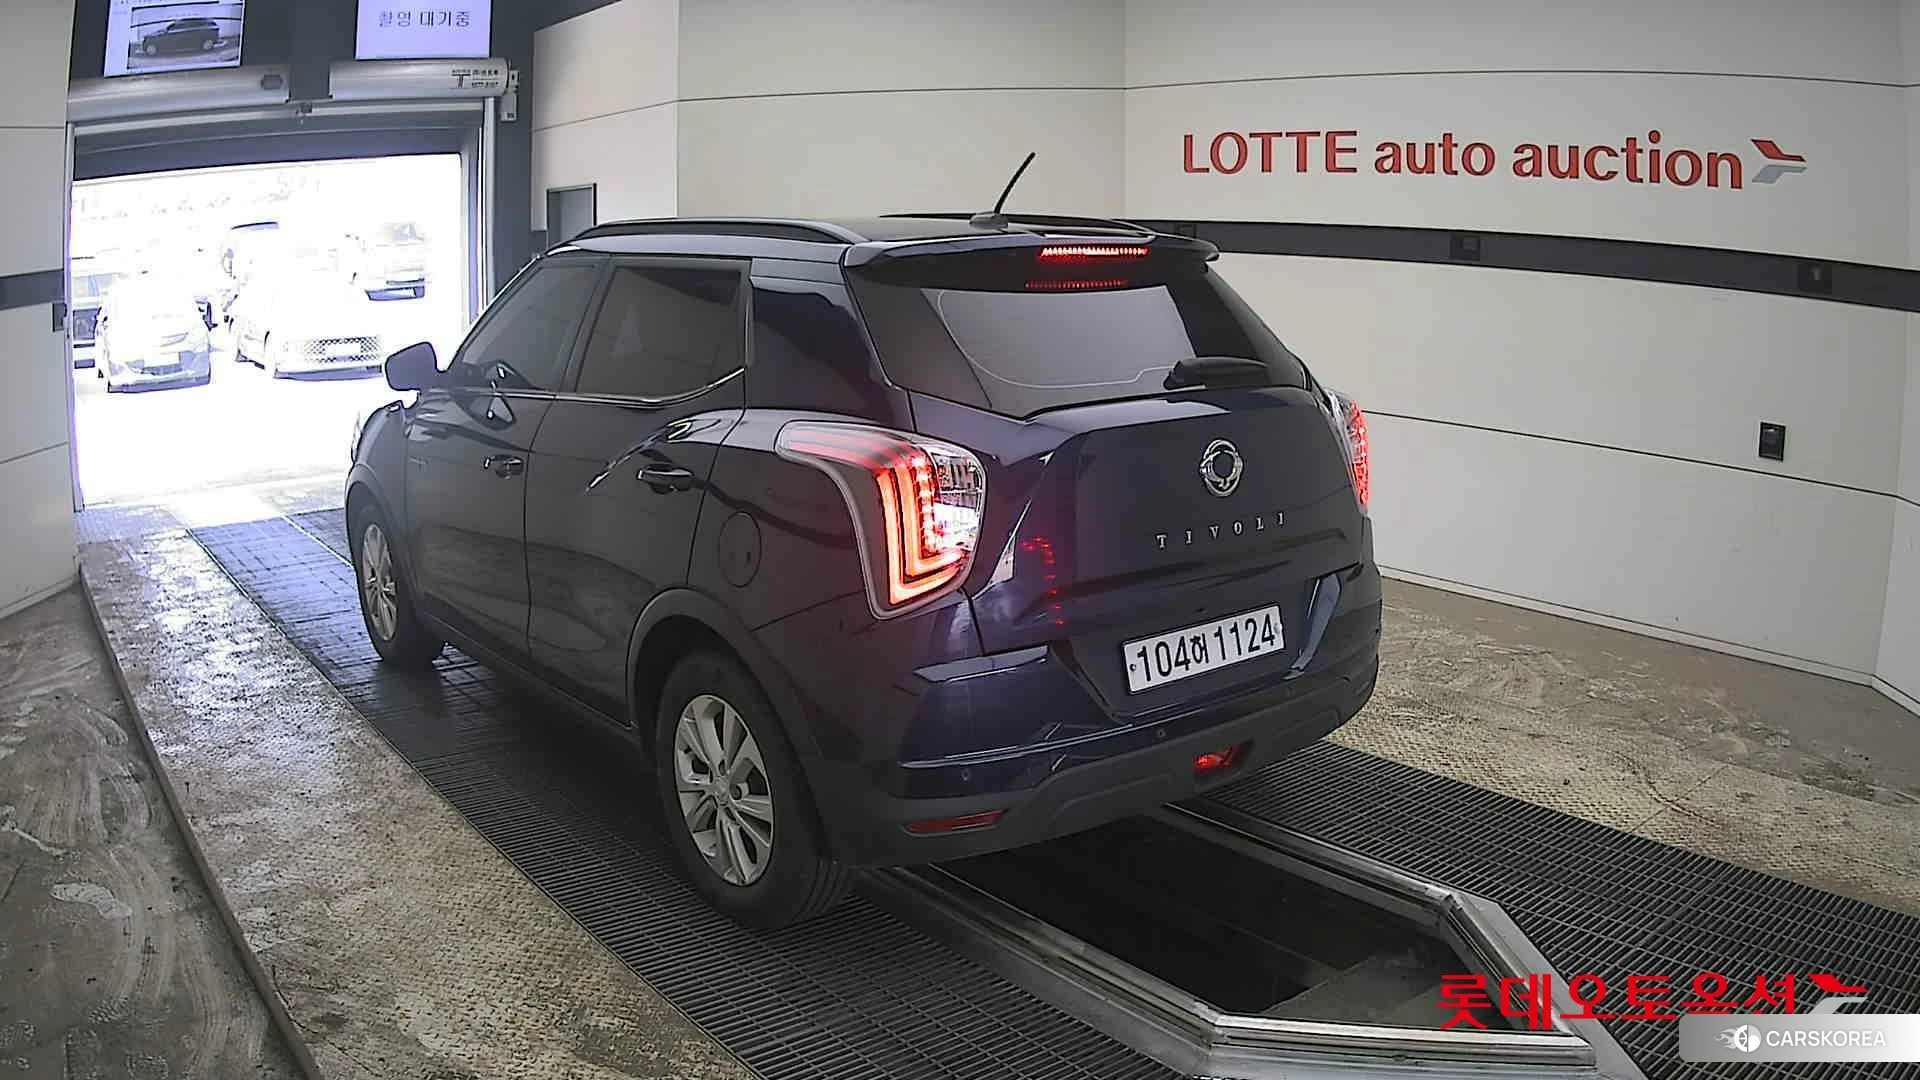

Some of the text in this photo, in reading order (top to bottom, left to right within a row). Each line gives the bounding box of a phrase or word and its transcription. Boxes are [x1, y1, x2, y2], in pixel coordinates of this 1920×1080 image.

[420, 10, 471, 28] 대기중
[1184, 129, 1745, 189] LOTTE auto auction
[1155, 512, 1286, 550] TIVOLI
